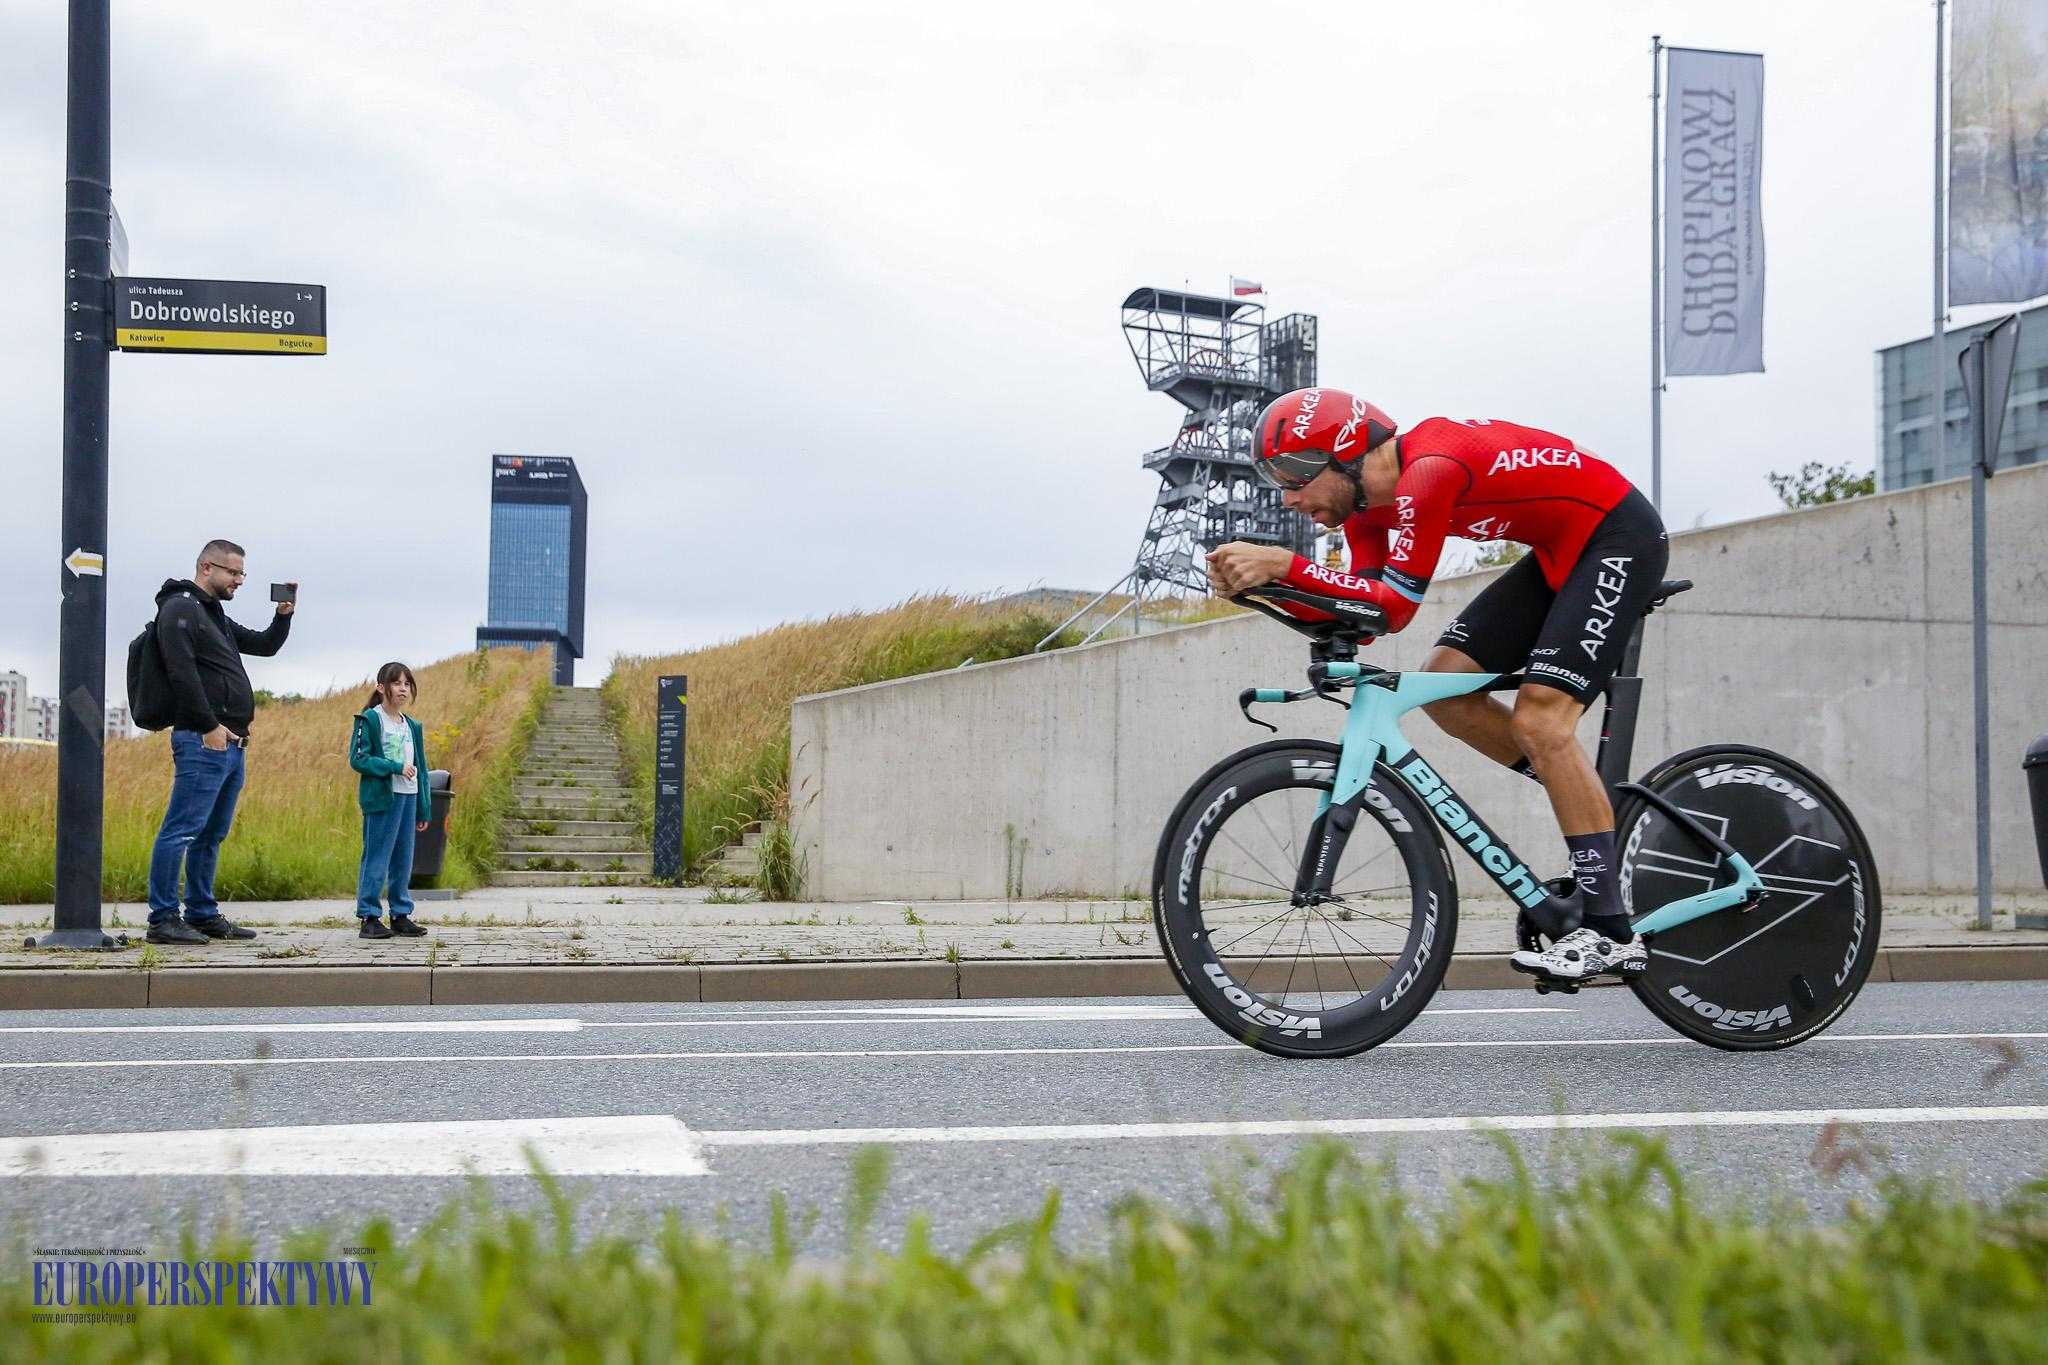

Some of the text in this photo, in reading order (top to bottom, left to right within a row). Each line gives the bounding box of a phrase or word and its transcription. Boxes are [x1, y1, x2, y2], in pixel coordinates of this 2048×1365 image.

[128, 286, 184, 296] ulica Tadeusza
[129, 300, 295, 330] Dobrowolskiego
[129, 333, 165, 343] Katowice
[279, 338, 313, 348] Bogucice
[1291, 389, 1322, 440] ARKEA
[1488, 447, 1582, 476] ARKEA
[1391, 495, 1415, 561] ARKEA
[1302, 563, 1371, 593] ARKEA
[1579, 556, 1634, 661] ARKEA
[1531, 662, 1591, 687] Bianchi
[1693, 763, 1819, 811] Vision
[1400, 757, 1551, 909] Bianchi
[1835, 859, 1867, 988] metron
[1379, 889, 1439, 1011] metron
[1203, 963, 1322, 1039] Vision
[1669, 984, 1793, 1031] Vision
